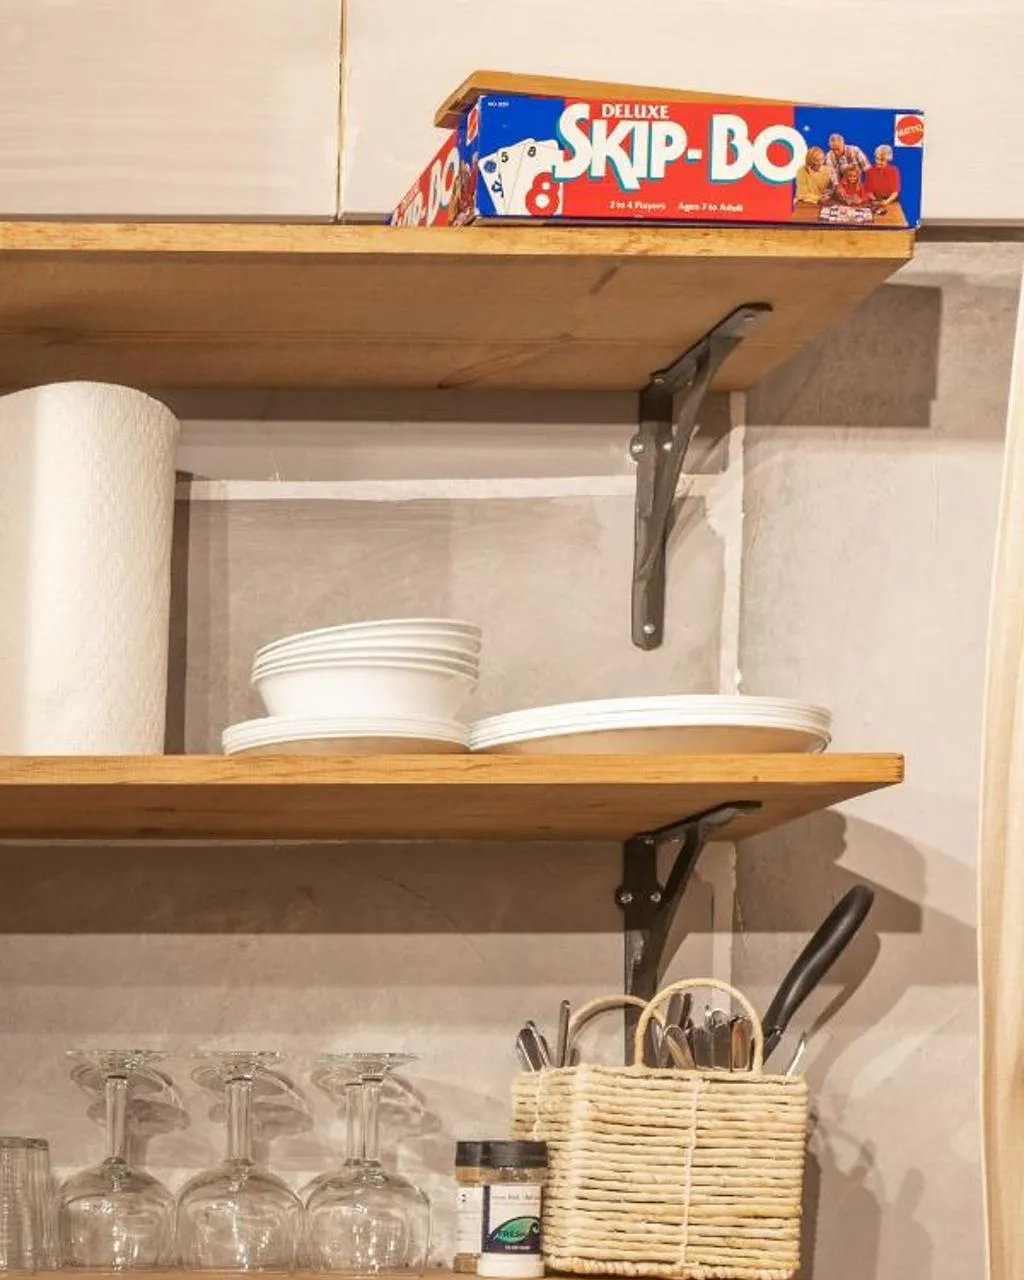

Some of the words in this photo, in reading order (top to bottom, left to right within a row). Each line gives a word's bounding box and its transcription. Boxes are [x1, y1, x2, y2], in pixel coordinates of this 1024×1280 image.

[601, 103, 669, 119] DELUXE
[551, 102, 809, 192] SKIP-BO
[501, 152, 509, 163] 5
[525, 172, 560, 216] 8
[609, 200, 616, 209] 2
[616, 201, 626, 209] to
[627, 200, 633, 209] 4
[634, 201, 667, 211] Players
[678, 202, 699, 212] Ages
[719, 202, 744, 212] Adult
